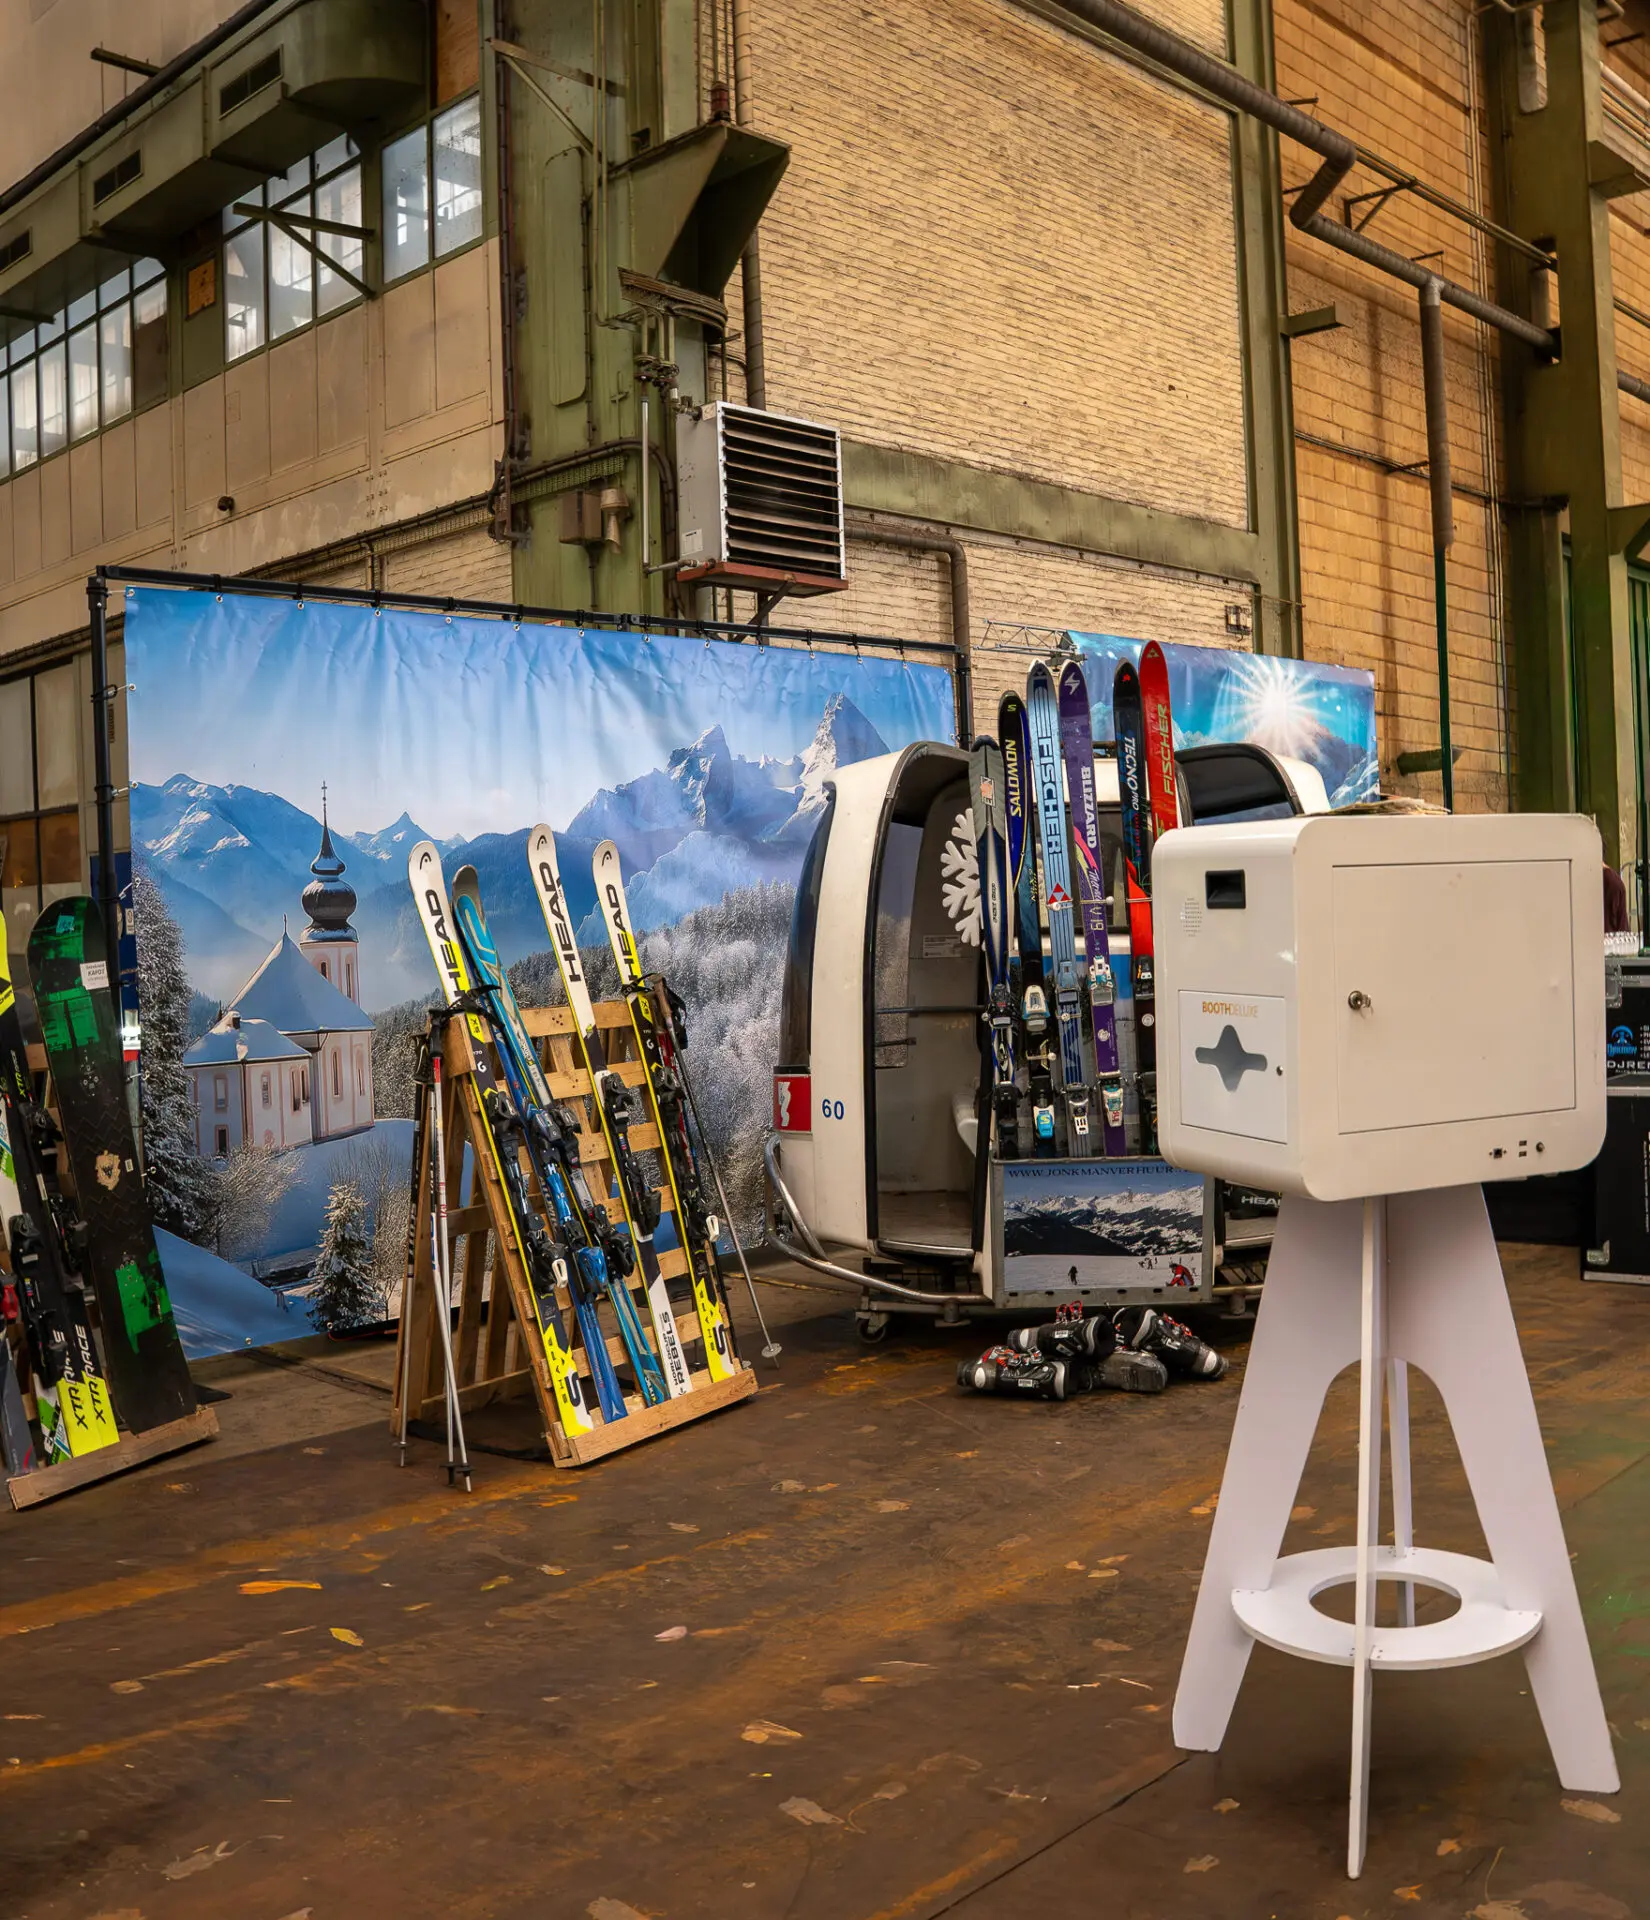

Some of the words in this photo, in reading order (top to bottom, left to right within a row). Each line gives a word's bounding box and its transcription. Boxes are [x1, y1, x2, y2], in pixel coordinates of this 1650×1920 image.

[1005, 739, 1022, 817] SALOMON
[1158, 703, 1174, 796] FISCHER
[981, 776, 993, 805] EN
[1037, 736, 1063, 856] FISCHER
[1081, 766, 1096, 849] BLIZZARD
[426, 889, 469, 1000] HEAD
[539, 862, 582, 983] HEAD
[607, 884, 642, 981] HEAD
[1606, 1060, 1650, 1069] DJRE
[822, 1098, 845, 1120] 60
[75, 1324, 97, 1380] RACE
[662, 1311, 685, 1384] REBELS
[662, 1333, 679, 1386] WORLDCUP
[68, 1385, 88, 1430] XTR
[89, 1380, 106, 1425] XTR
